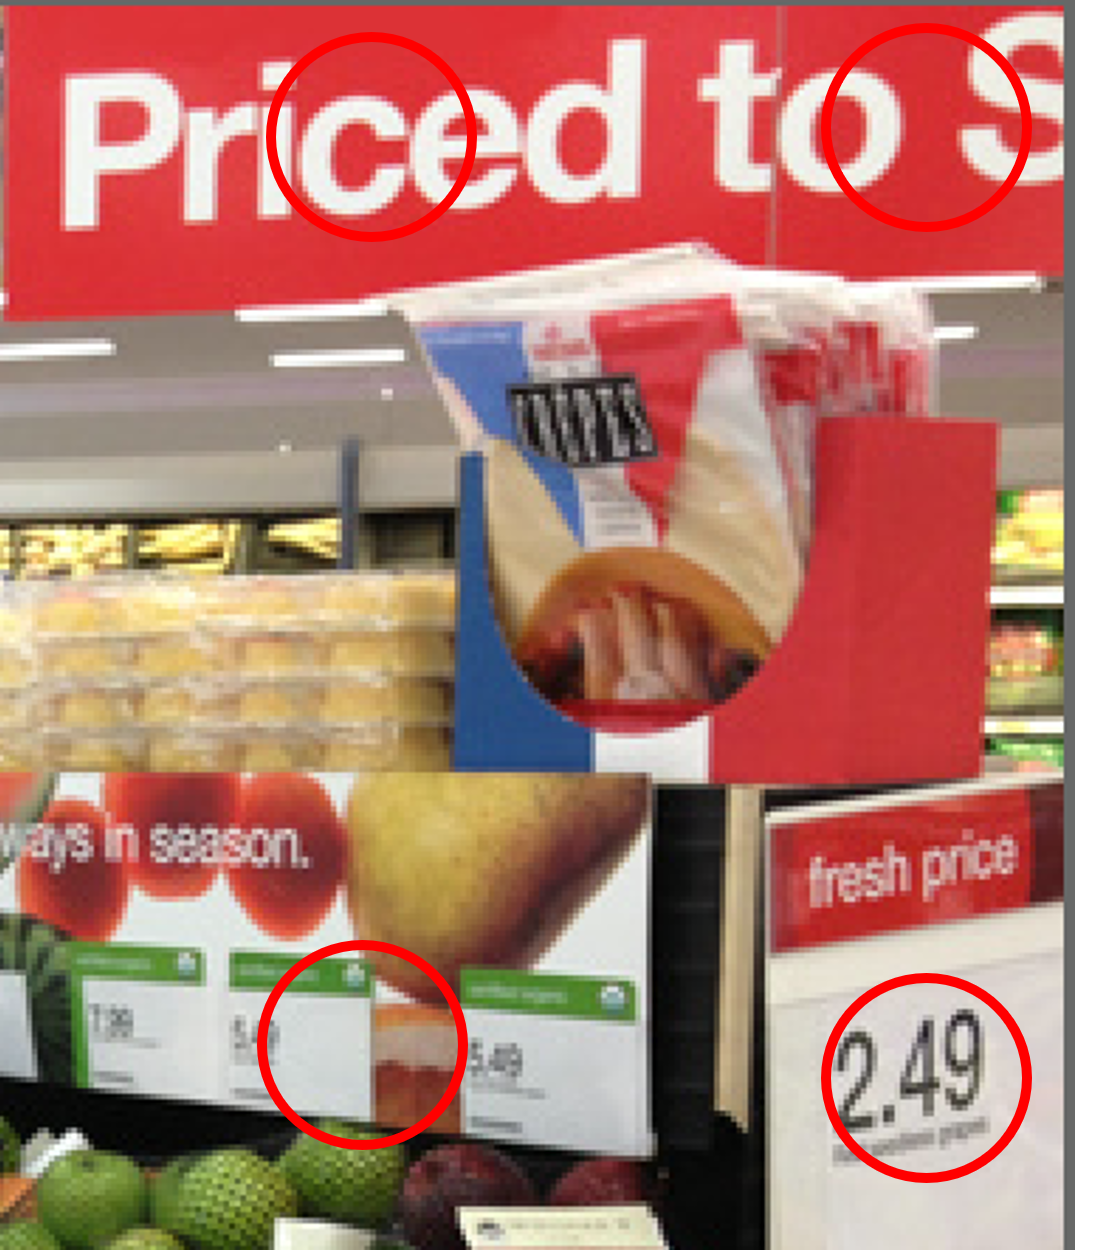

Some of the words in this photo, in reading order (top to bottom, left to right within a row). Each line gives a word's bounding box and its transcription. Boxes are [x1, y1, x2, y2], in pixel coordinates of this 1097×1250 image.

[60, 38, 644, 232] Priced
[696, 38, 902, 195] to
[104, 812, 140, 864] in
[150, 822, 313, 869] season.
[810, 840, 912, 908] fresh
[922, 829, 1020, 903] price
[834, 1009, 985, 1135] 2.49
